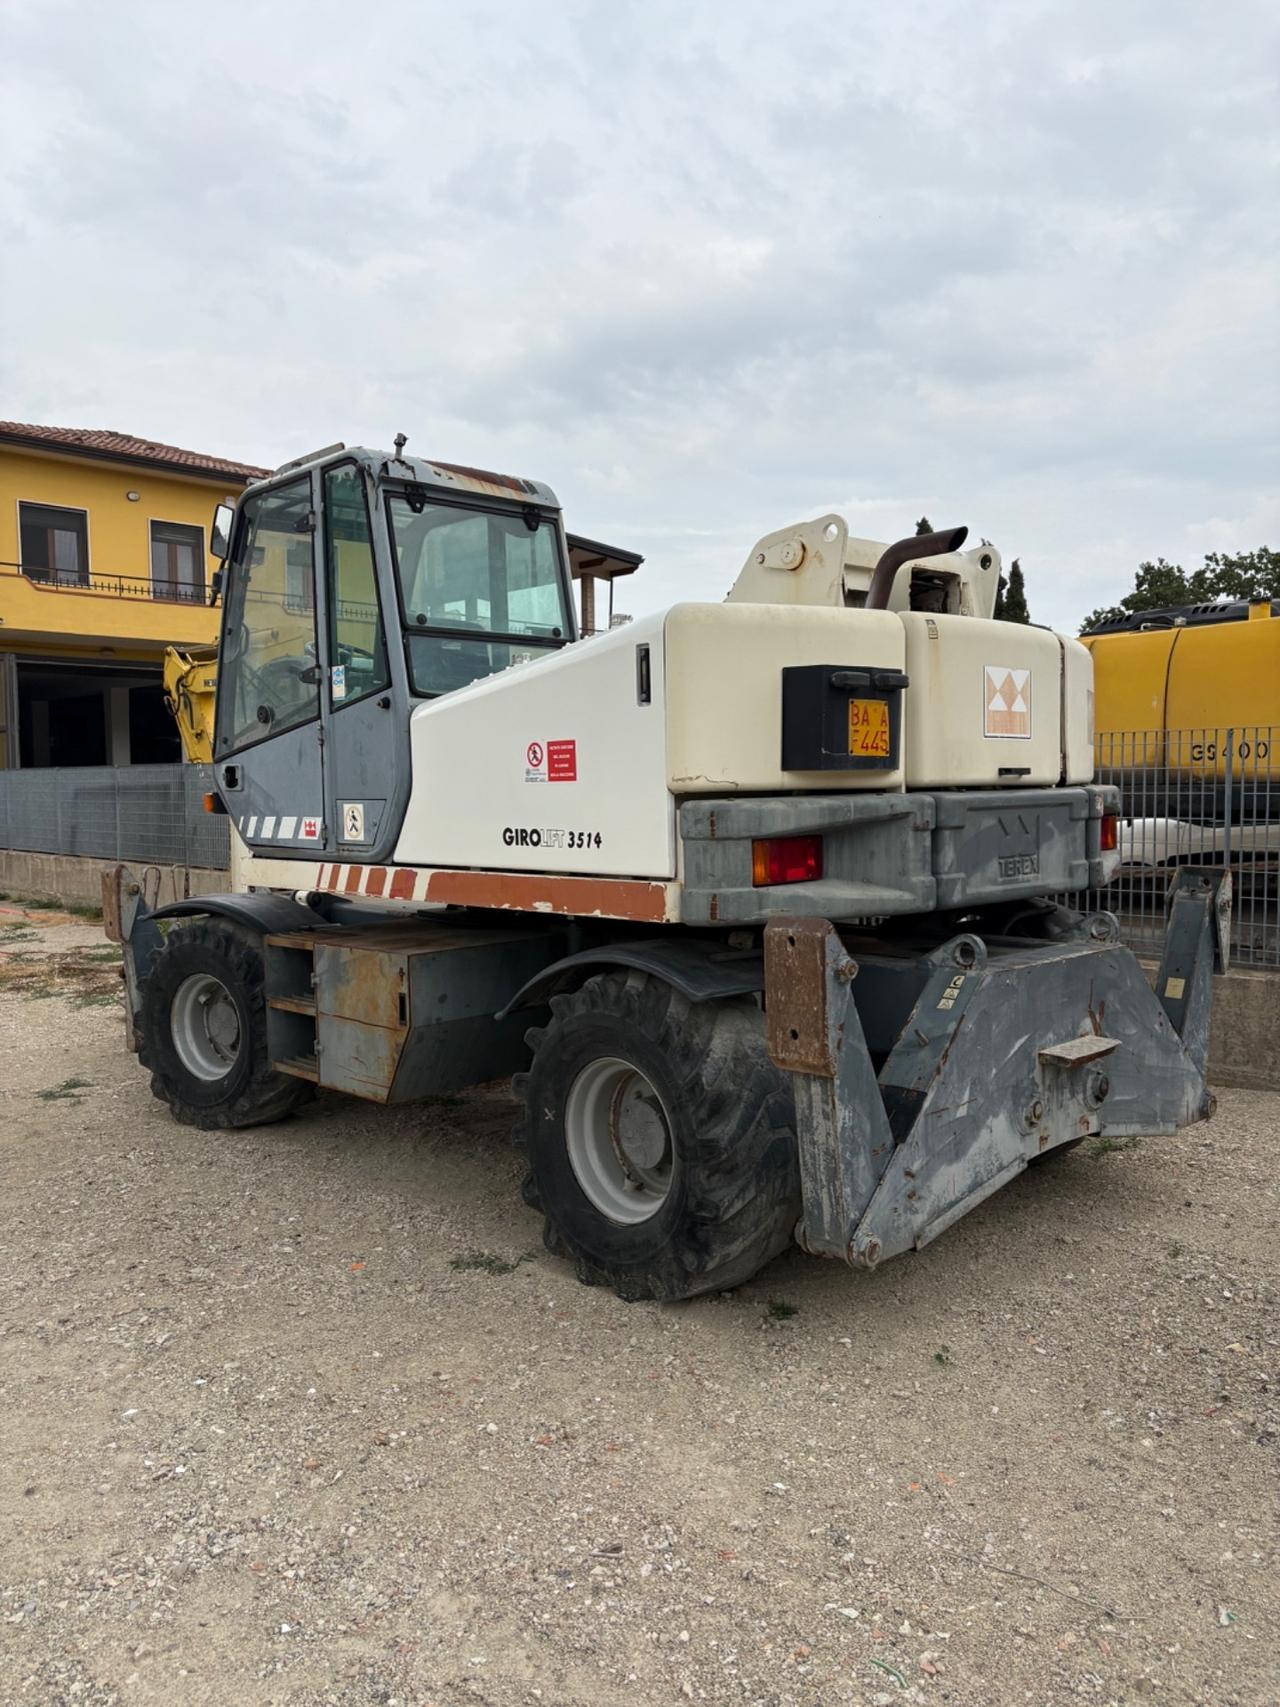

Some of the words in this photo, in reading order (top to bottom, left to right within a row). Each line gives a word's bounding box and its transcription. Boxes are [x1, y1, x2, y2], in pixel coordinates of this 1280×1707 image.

[851, 703, 870, 726] BA
[567, 831, 602, 848] 3514
[998, 857, 1039, 879] TEREX
